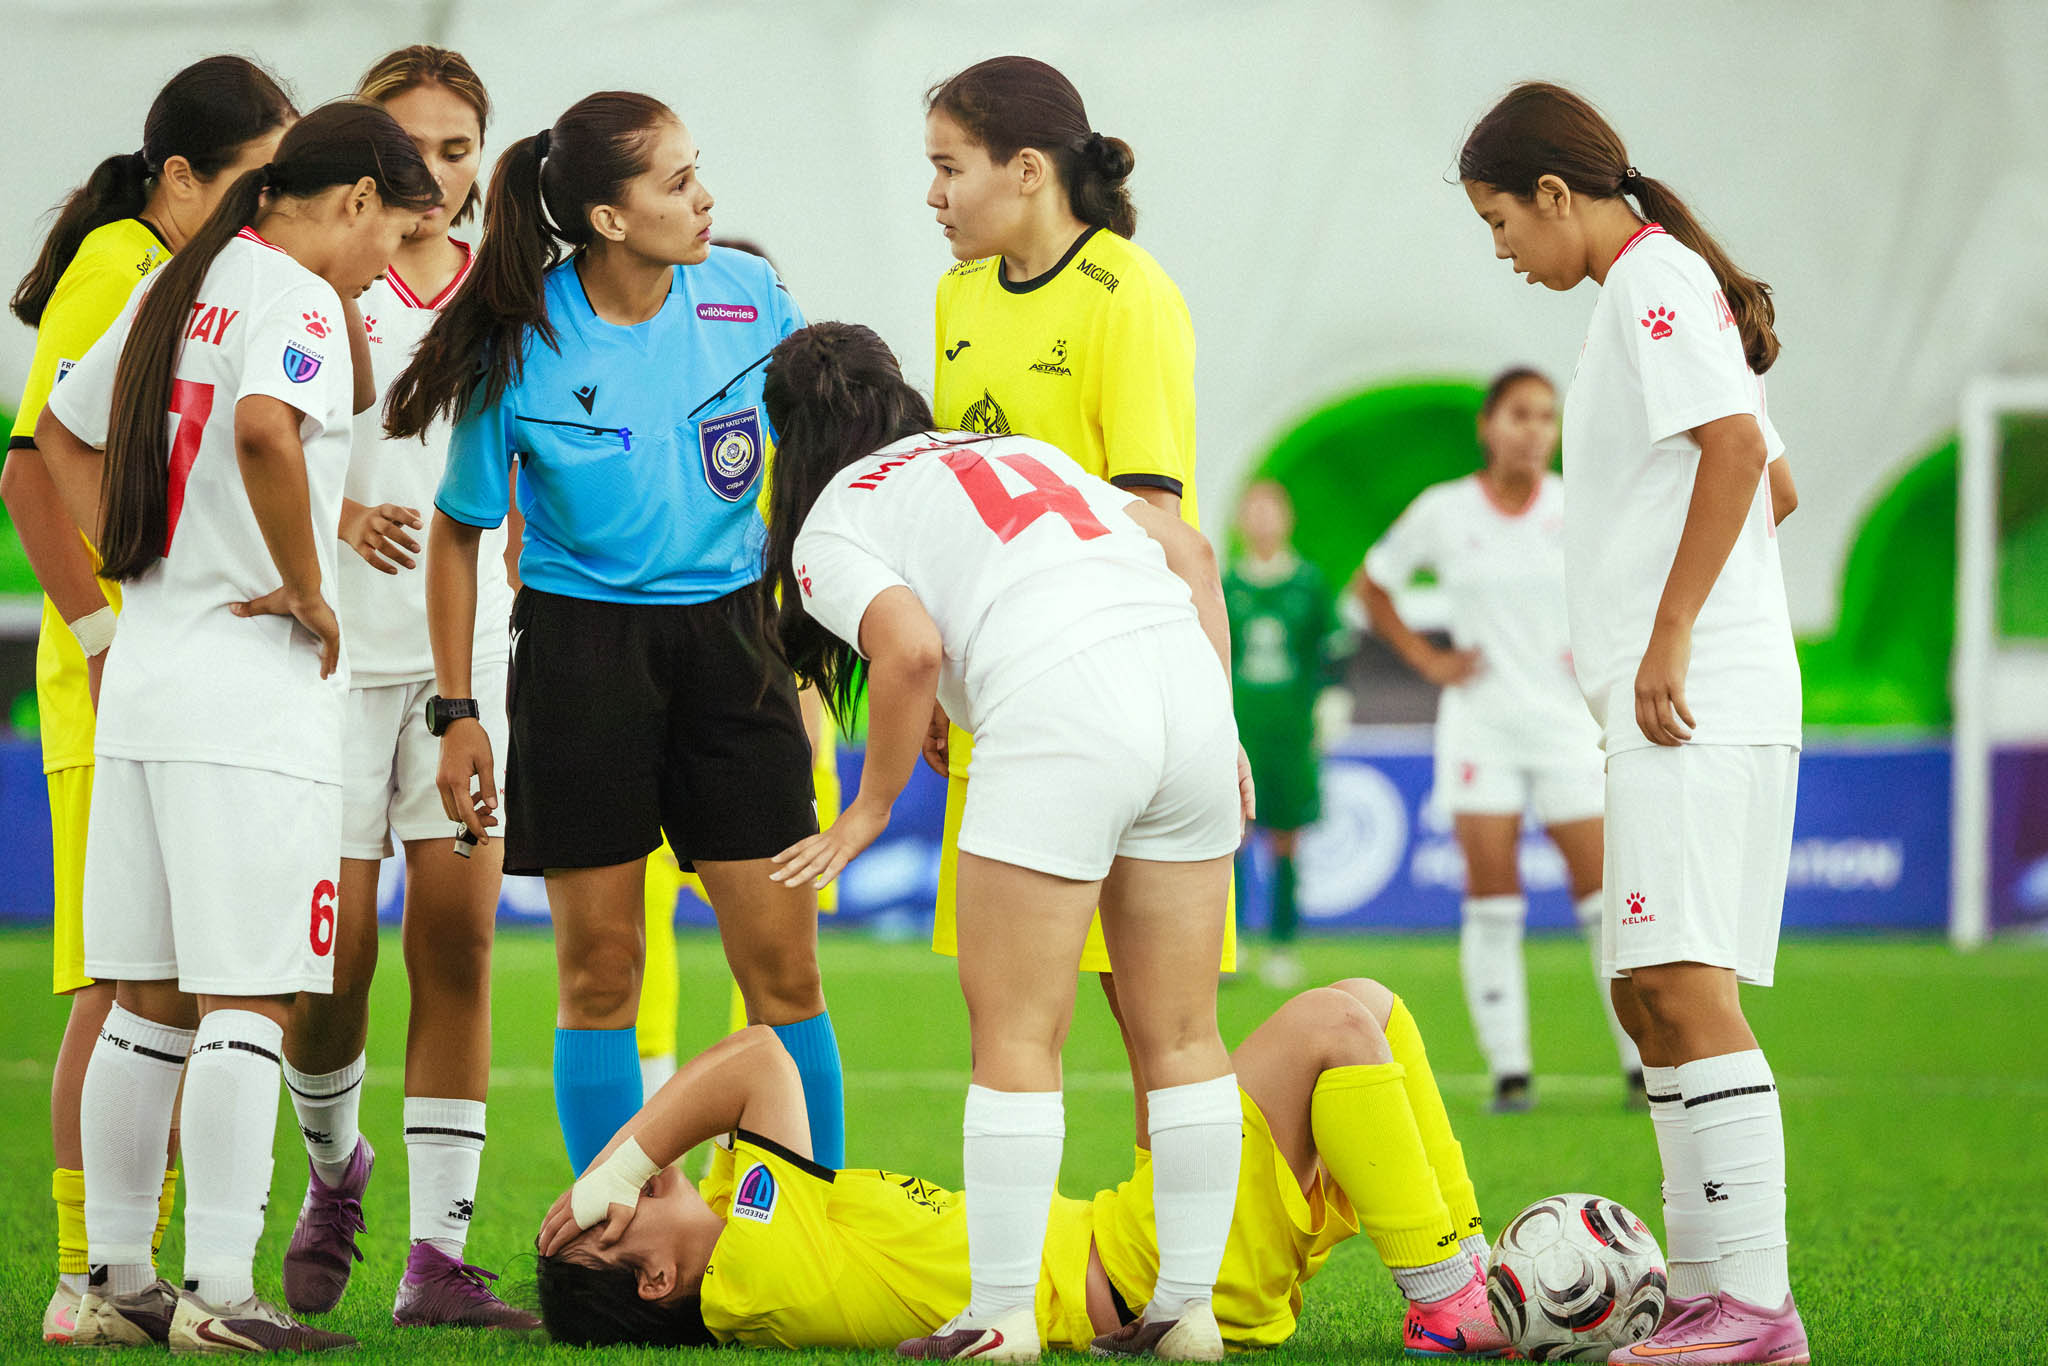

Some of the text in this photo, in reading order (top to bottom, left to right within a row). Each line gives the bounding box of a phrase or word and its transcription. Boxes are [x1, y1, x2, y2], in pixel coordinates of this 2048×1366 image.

[699, 306, 754, 319] wildberries
[287, 339, 325, 361] FREEDOM
[1028, 363, 1072, 377] ASTANA
[938, 448, 1113, 545] 4
[1621, 914, 1657, 927] KELME
[735, 1207, 769, 1220] FREEDOM
